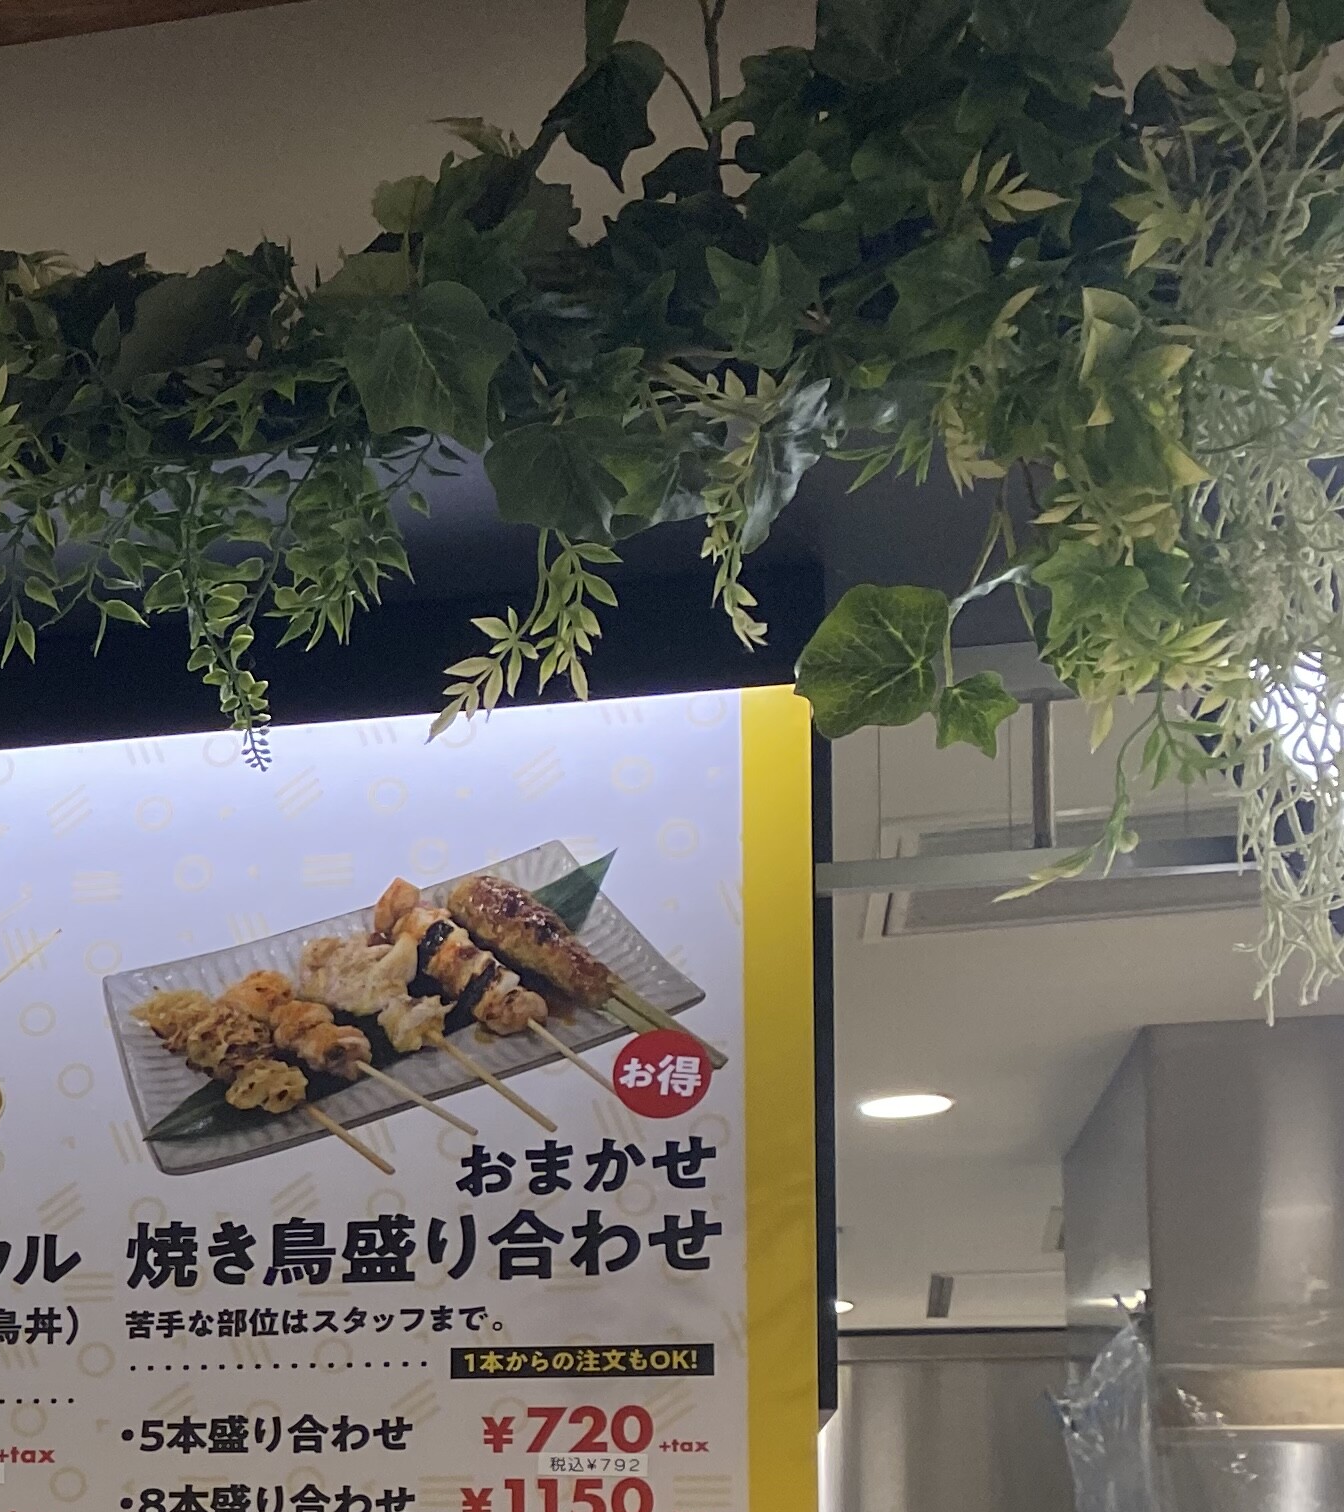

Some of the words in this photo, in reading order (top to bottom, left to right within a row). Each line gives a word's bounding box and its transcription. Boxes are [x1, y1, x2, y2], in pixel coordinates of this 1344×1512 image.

[620, 1054, 703, 1097] お得
[456, 1135, 717, 1197] おまかせ
[126, 1208, 723, 1290] 焼き鳥盛り合わせ
[125, 1304, 505, 1340] 苦手な部位はスタッフまで。
[464, 1347, 698, 1373] 1本からの注文もOK!
[482, 1404, 654, 1454] ¥720
[659, 1438, 710, 1454] +tax
[550, 1456, 641, 1473] 税込¥792
